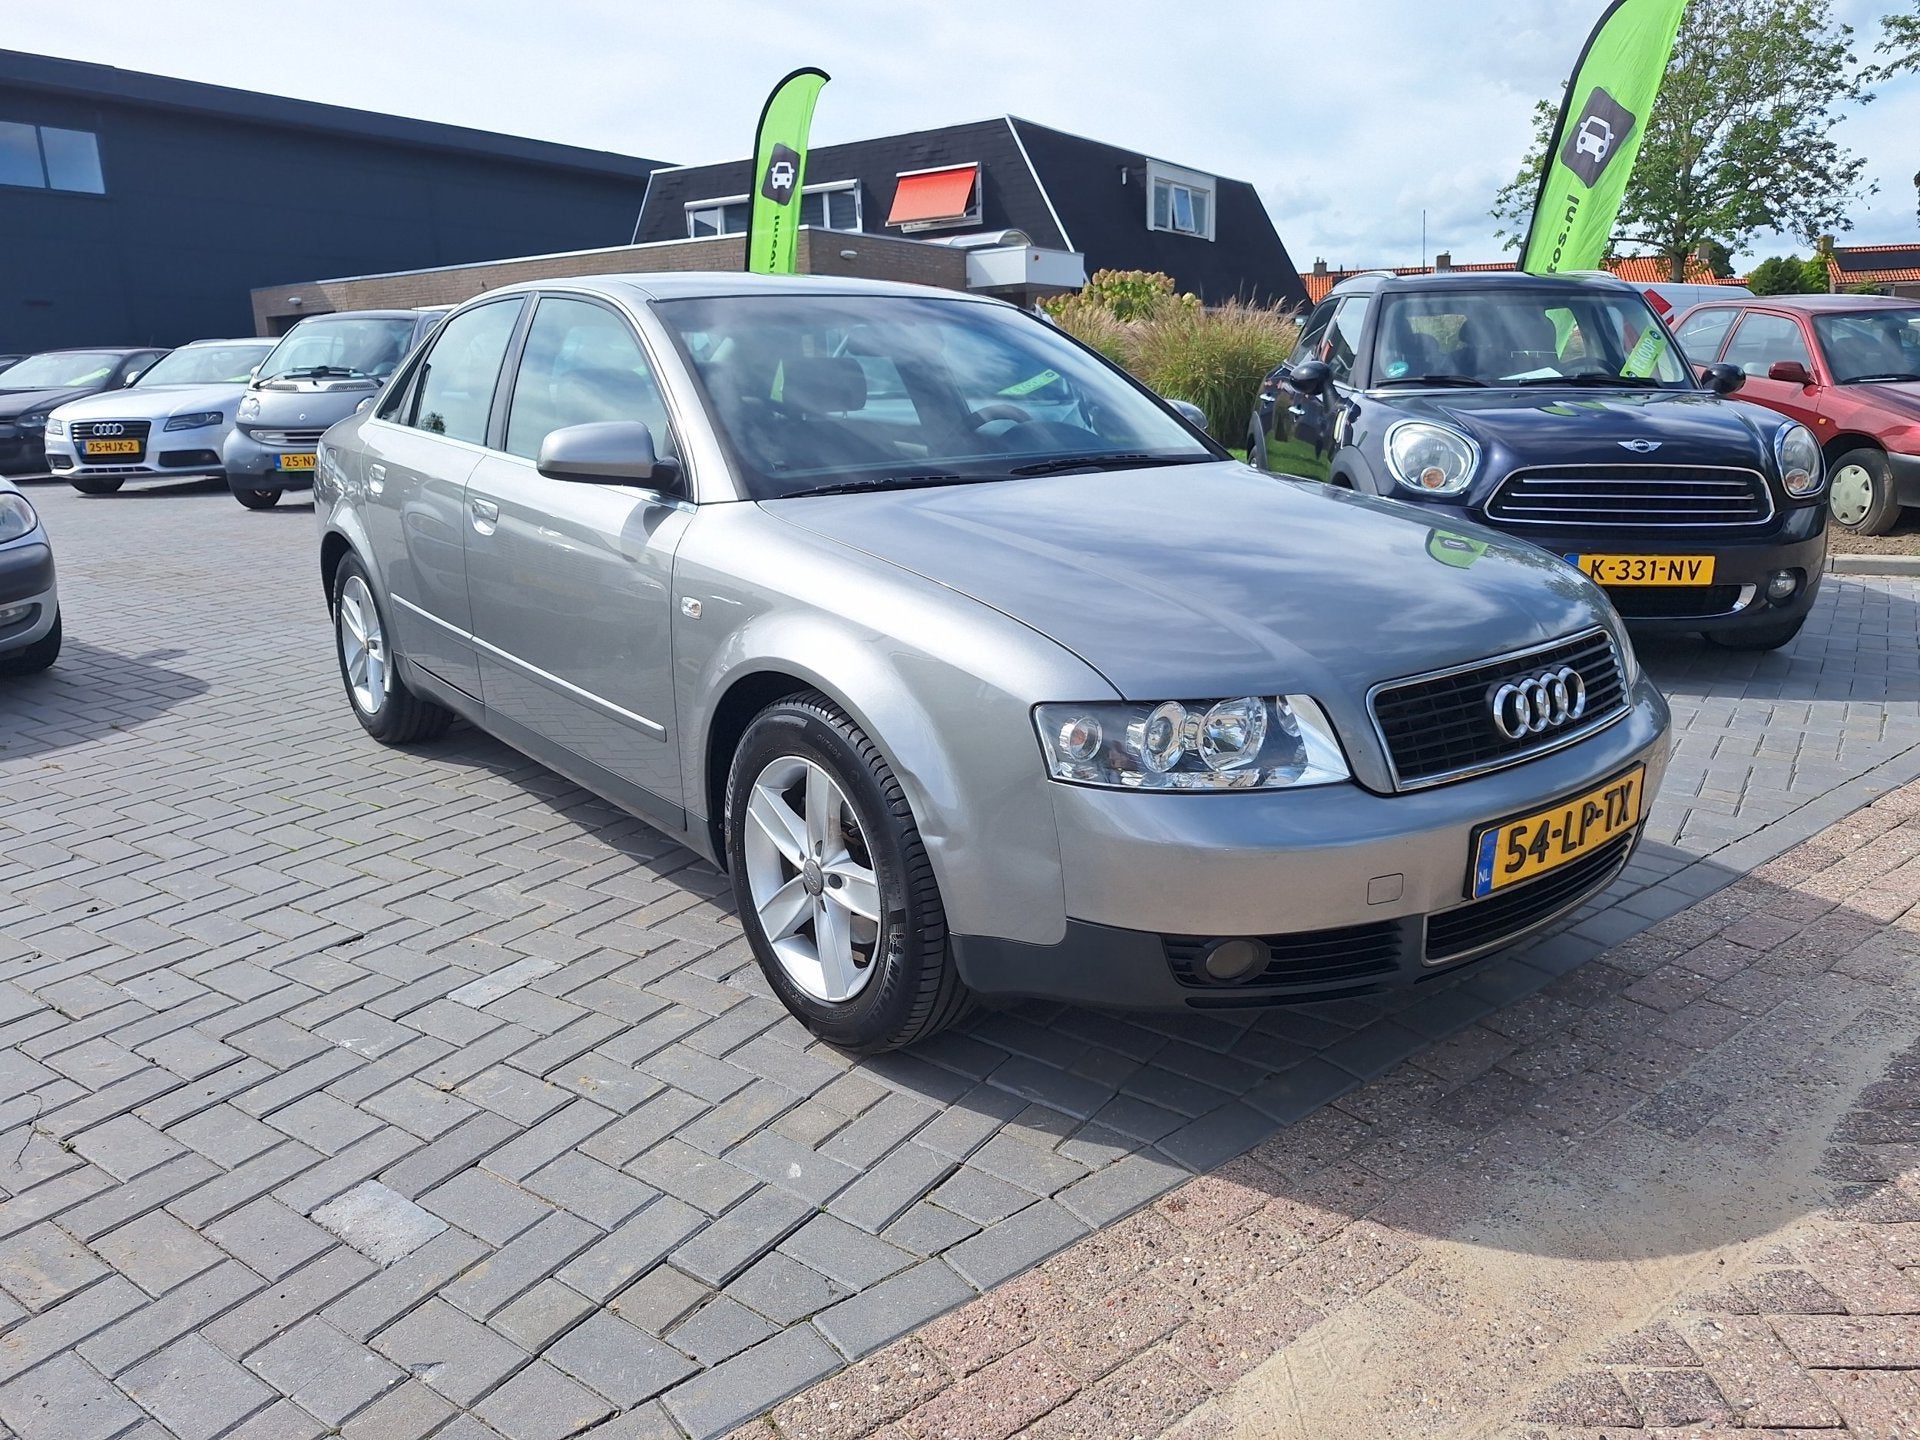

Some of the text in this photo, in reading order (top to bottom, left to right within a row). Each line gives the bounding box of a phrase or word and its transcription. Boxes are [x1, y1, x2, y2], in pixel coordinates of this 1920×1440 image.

[90, 442, 134, 452] 25-HJX-2
[1590, 559, 1702, 581] K-331-NV
[1505, 780, 1633, 874] 54-LP-TX
[1478, 868, 1490, 884] NL
